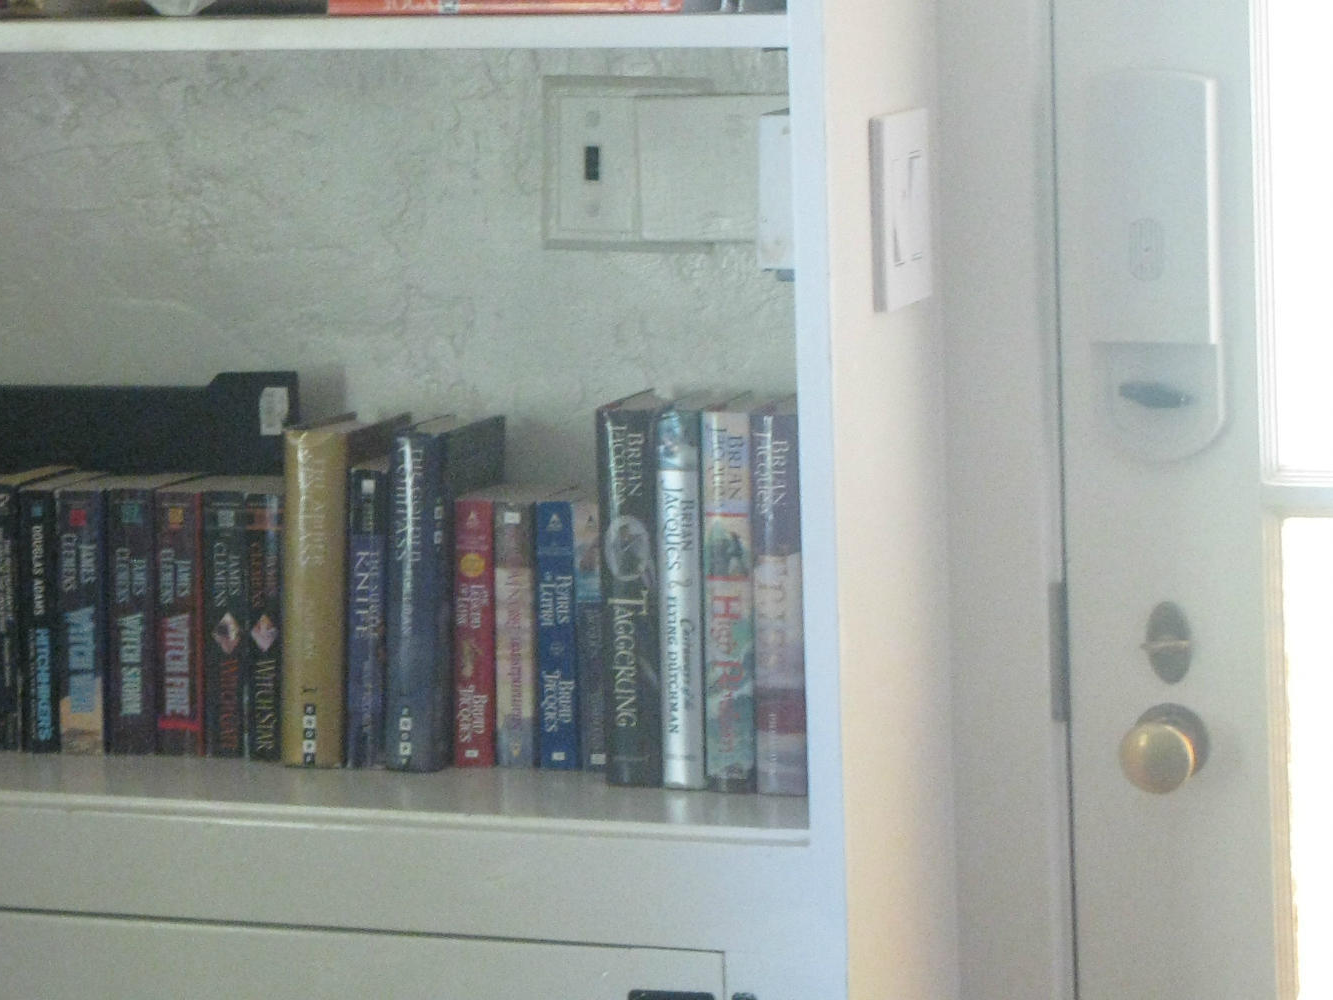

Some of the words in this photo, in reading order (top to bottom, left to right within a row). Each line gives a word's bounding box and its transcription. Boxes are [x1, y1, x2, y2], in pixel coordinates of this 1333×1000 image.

[625, 431, 646, 499] BRIAN
[726, 435, 747, 500] BRIAN
[770, 438, 791, 508] BRIAN
[31, 524, 45, 575] DOUGLAS
[662, 486, 684, 572] JACQUES
[680, 498, 697, 553] BRIAN
[62, 533, 79, 593] CLEMENS
[159, 547, 175, 605] CLEMENS
[173, 559, 192, 598] JAMES
[213, 541, 229, 608] CLEMENS
[32, 579, 46, 616] ADAMS
[666, 597, 679, 647] FLYING
[709, 594, 744, 656] High
[117, 612, 144, 662] WITCH
[162, 613, 191, 672] WITCH
[609, 590, 649, 728] TAGGERUNG
[34, 627, 54, 740] HITCHHIKER'S
[120, 666, 143, 717] STORM
[164, 675, 191, 717] FIRE
[667, 650, 680, 736] DUTCHMAN
